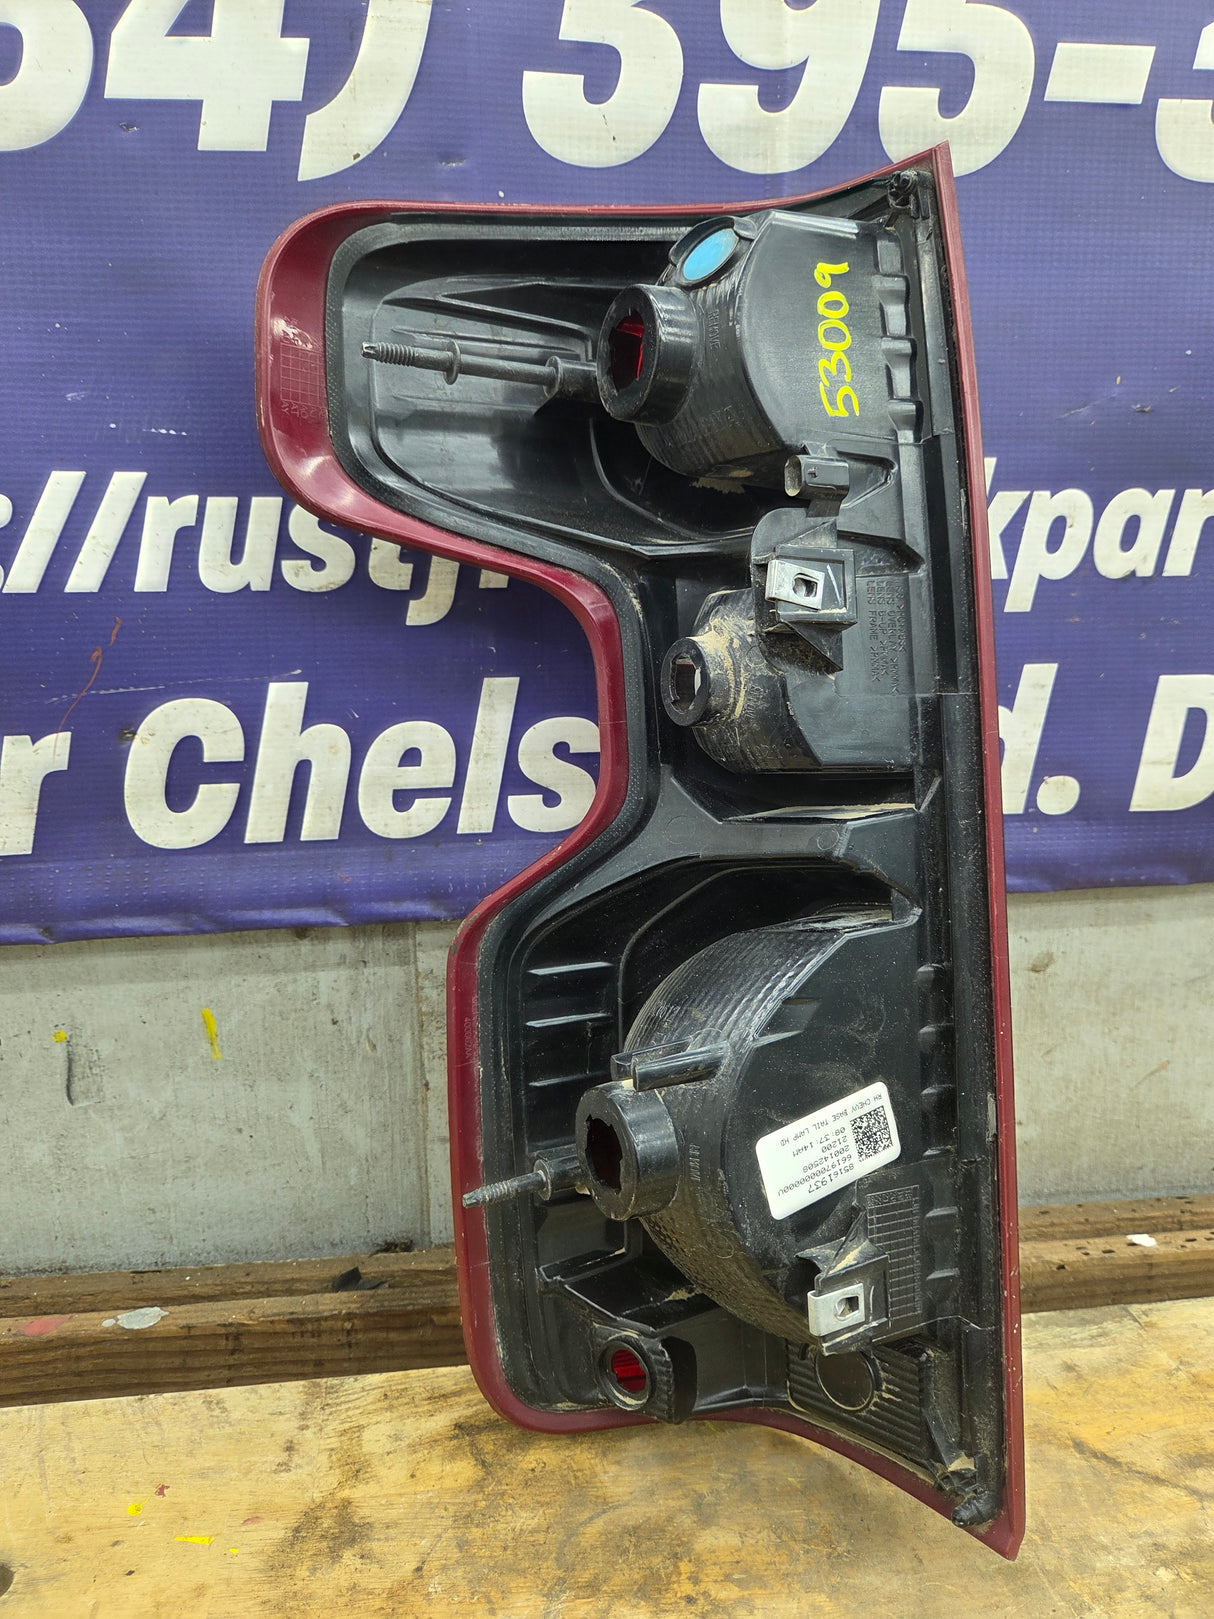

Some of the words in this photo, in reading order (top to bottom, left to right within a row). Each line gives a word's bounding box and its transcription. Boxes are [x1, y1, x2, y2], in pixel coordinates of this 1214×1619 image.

[814, 262, 859, 417] 53009
[866, 580, 876, 605] LENS
[868, 610, 878, 640] FRAME
[124, 677, 600, 849] Chels
[851, 1098, 871, 1113] CHEVY
[873, 1093, 883, 1101] RH
[812, 1119, 829, 1130] TAIL
[832, 1109, 848, 1122] BASE
[780, 1136, 790, 1146] HD
[792, 1127, 810, 1141] LAMP
[822, 1135, 848, 1153] 21200
[803, 1144, 850, 1173] 200142508
[808, 1163, 854, 1193] 85161937
